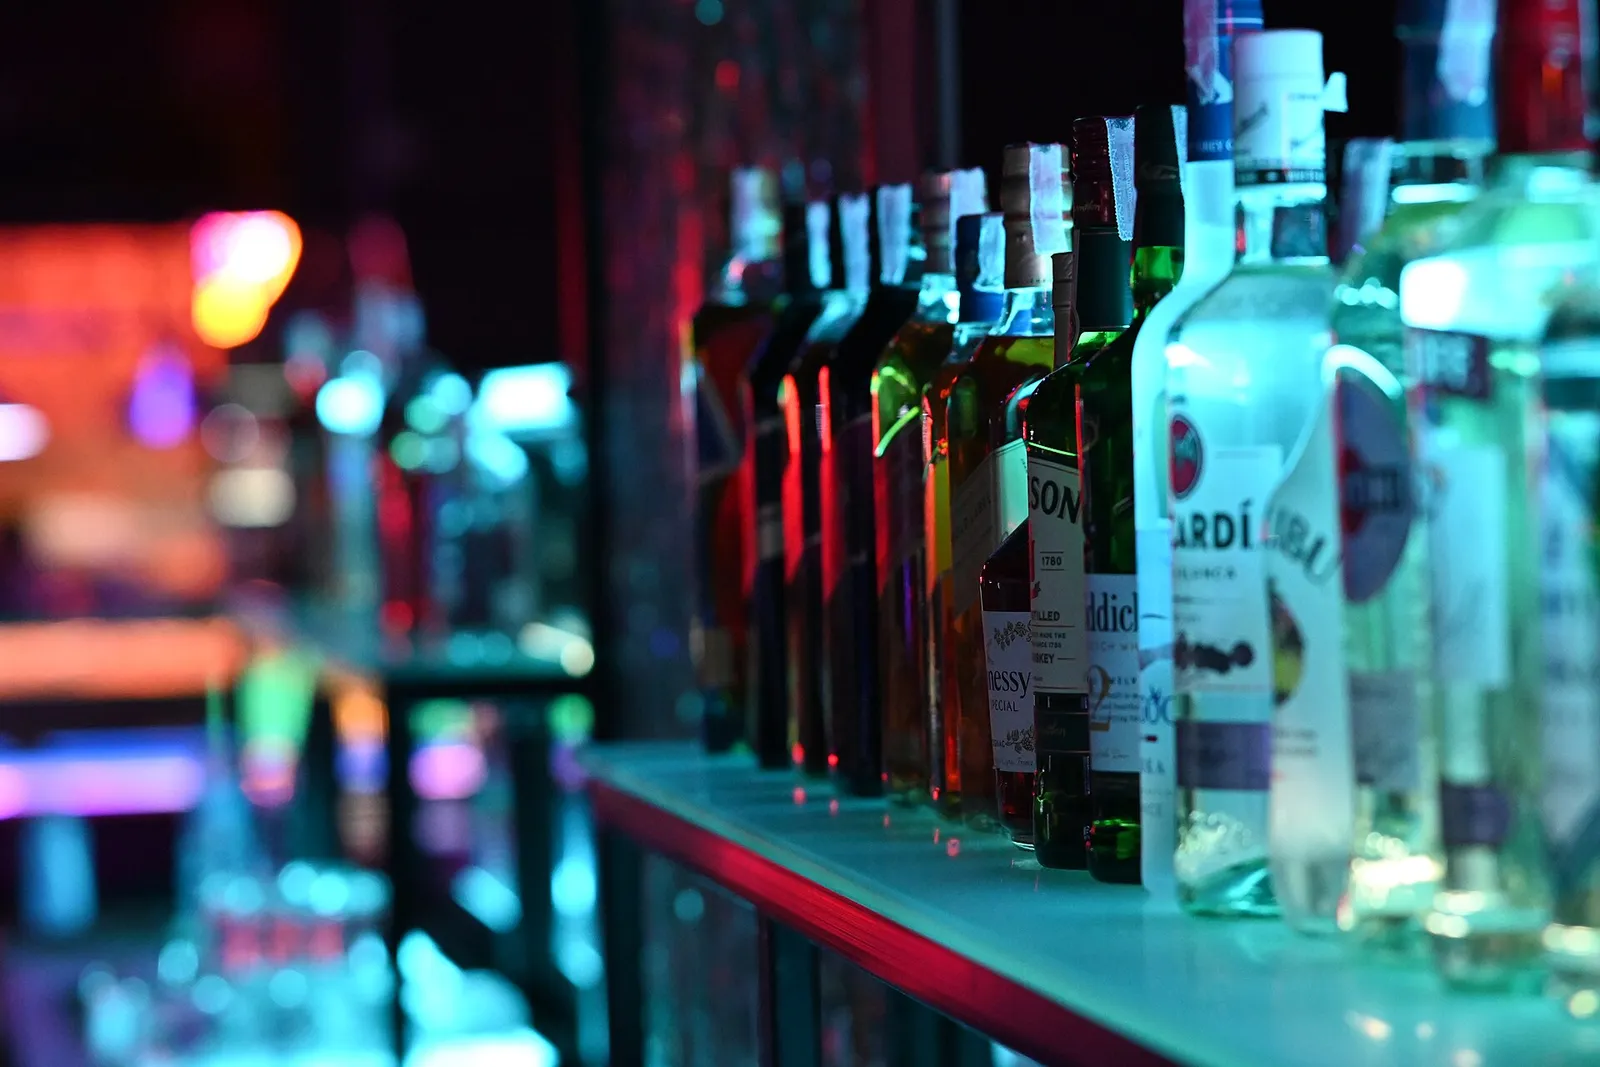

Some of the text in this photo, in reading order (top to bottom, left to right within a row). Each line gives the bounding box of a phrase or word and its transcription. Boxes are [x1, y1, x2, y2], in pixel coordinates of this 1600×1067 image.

[1029, 476, 1081, 525] SON
[1041, 555, 1062, 567] 1780
[988, 670, 1032, 699] nessy
